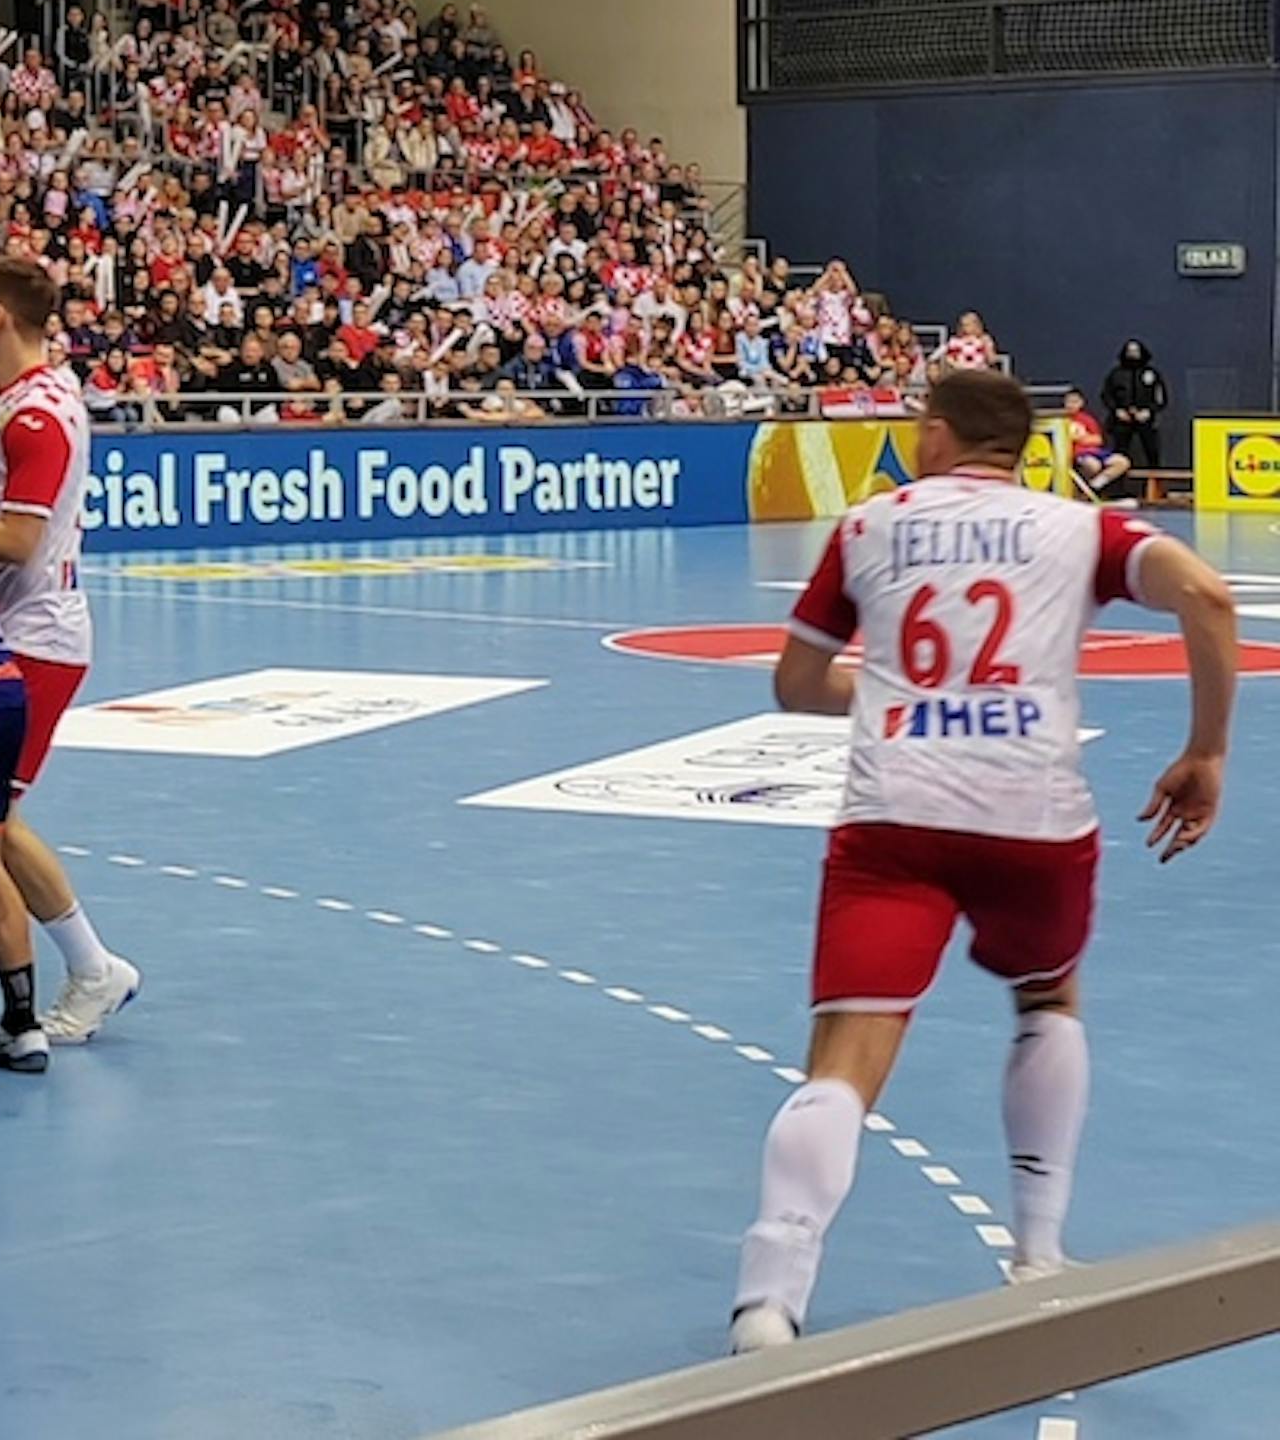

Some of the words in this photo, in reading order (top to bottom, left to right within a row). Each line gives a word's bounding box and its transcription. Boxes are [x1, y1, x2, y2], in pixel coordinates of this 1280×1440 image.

[194, 449, 343, 525] Fresh
[357, 445, 487, 520] Food
[498, 446, 681, 515] Partner
[889, 508, 1040, 584] JELINIĆ
[899, 577, 1021, 689] 62
[936, 698, 1044, 738] HEP
